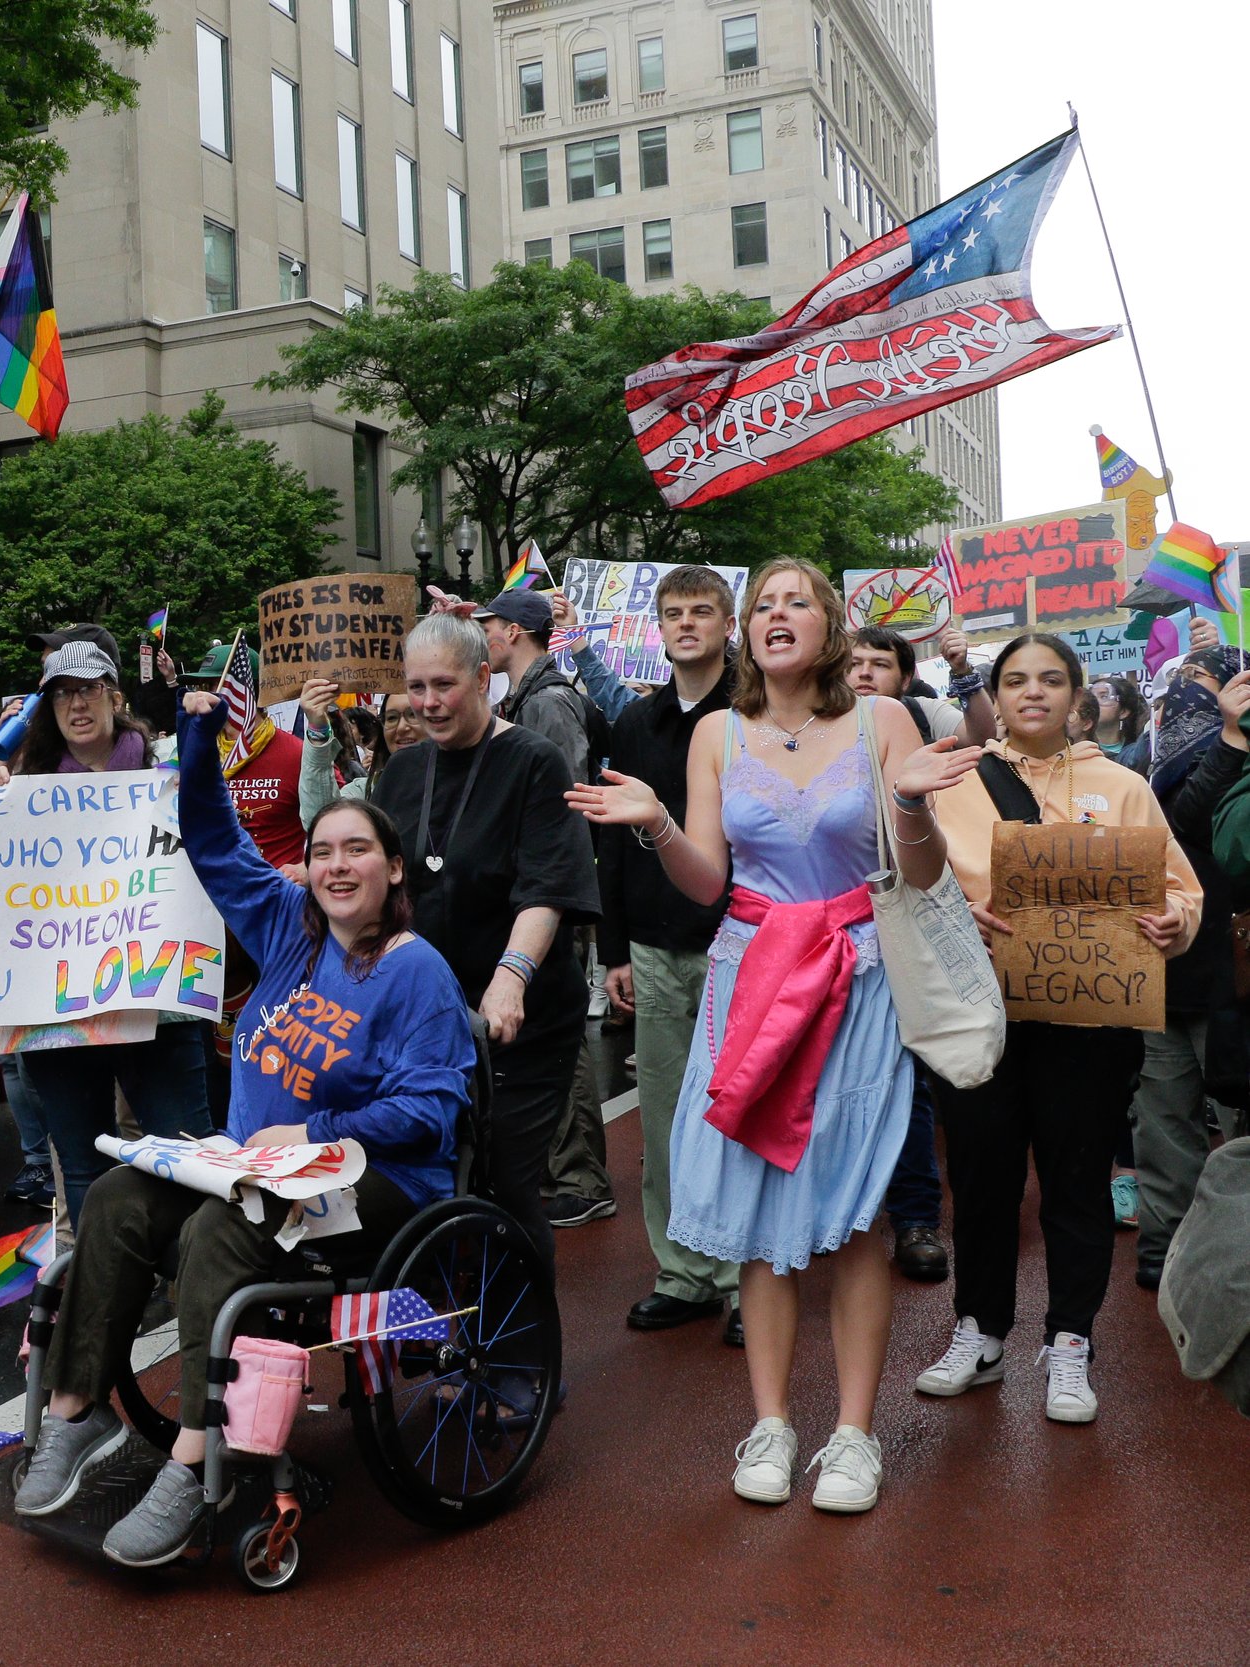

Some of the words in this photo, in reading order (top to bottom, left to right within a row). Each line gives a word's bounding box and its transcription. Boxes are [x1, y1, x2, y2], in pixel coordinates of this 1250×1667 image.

[983, 517, 1079, 556] NEVER
[261, 589, 304, 617] THIS
[312, 584, 341, 606] IS
[349, 583, 384, 605] FOR
[986, 582, 1026, 608] MY
[1036, 580, 1126, 615] REALITY
[264, 617, 285, 642] MY
[289, 612, 404, 637] STUDENTS
[263, 640, 332, 666] LIVING
[333, 638, 367, 659] IN
[369, 638, 405, 662] FEA
[1095, 650, 1114, 662] LET
[1118, 646, 1137, 660] HIM
[27, 779, 167, 816] CAREFU
[229, 779, 281, 789] ETLIGHT
[76, 835, 138, 868] YOU
[1021, 837, 1133, 871] WILL
[5, 878, 120, 910] COULD
[128, 866, 176, 897] BE
[1006, 874, 1150, 908] SILENCE
[10, 901, 161, 949] SOMEONE
[1050, 909, 1096, 940] BE
[1025, 940, 1116, 970] YOUR
[55, 940, 222, 1014] LOVE
[1005, 970, 1147, 1006] LEGACY?
[237, 980, 313, 1062] Embrace
[289, 991, 362, 1040] OPE
